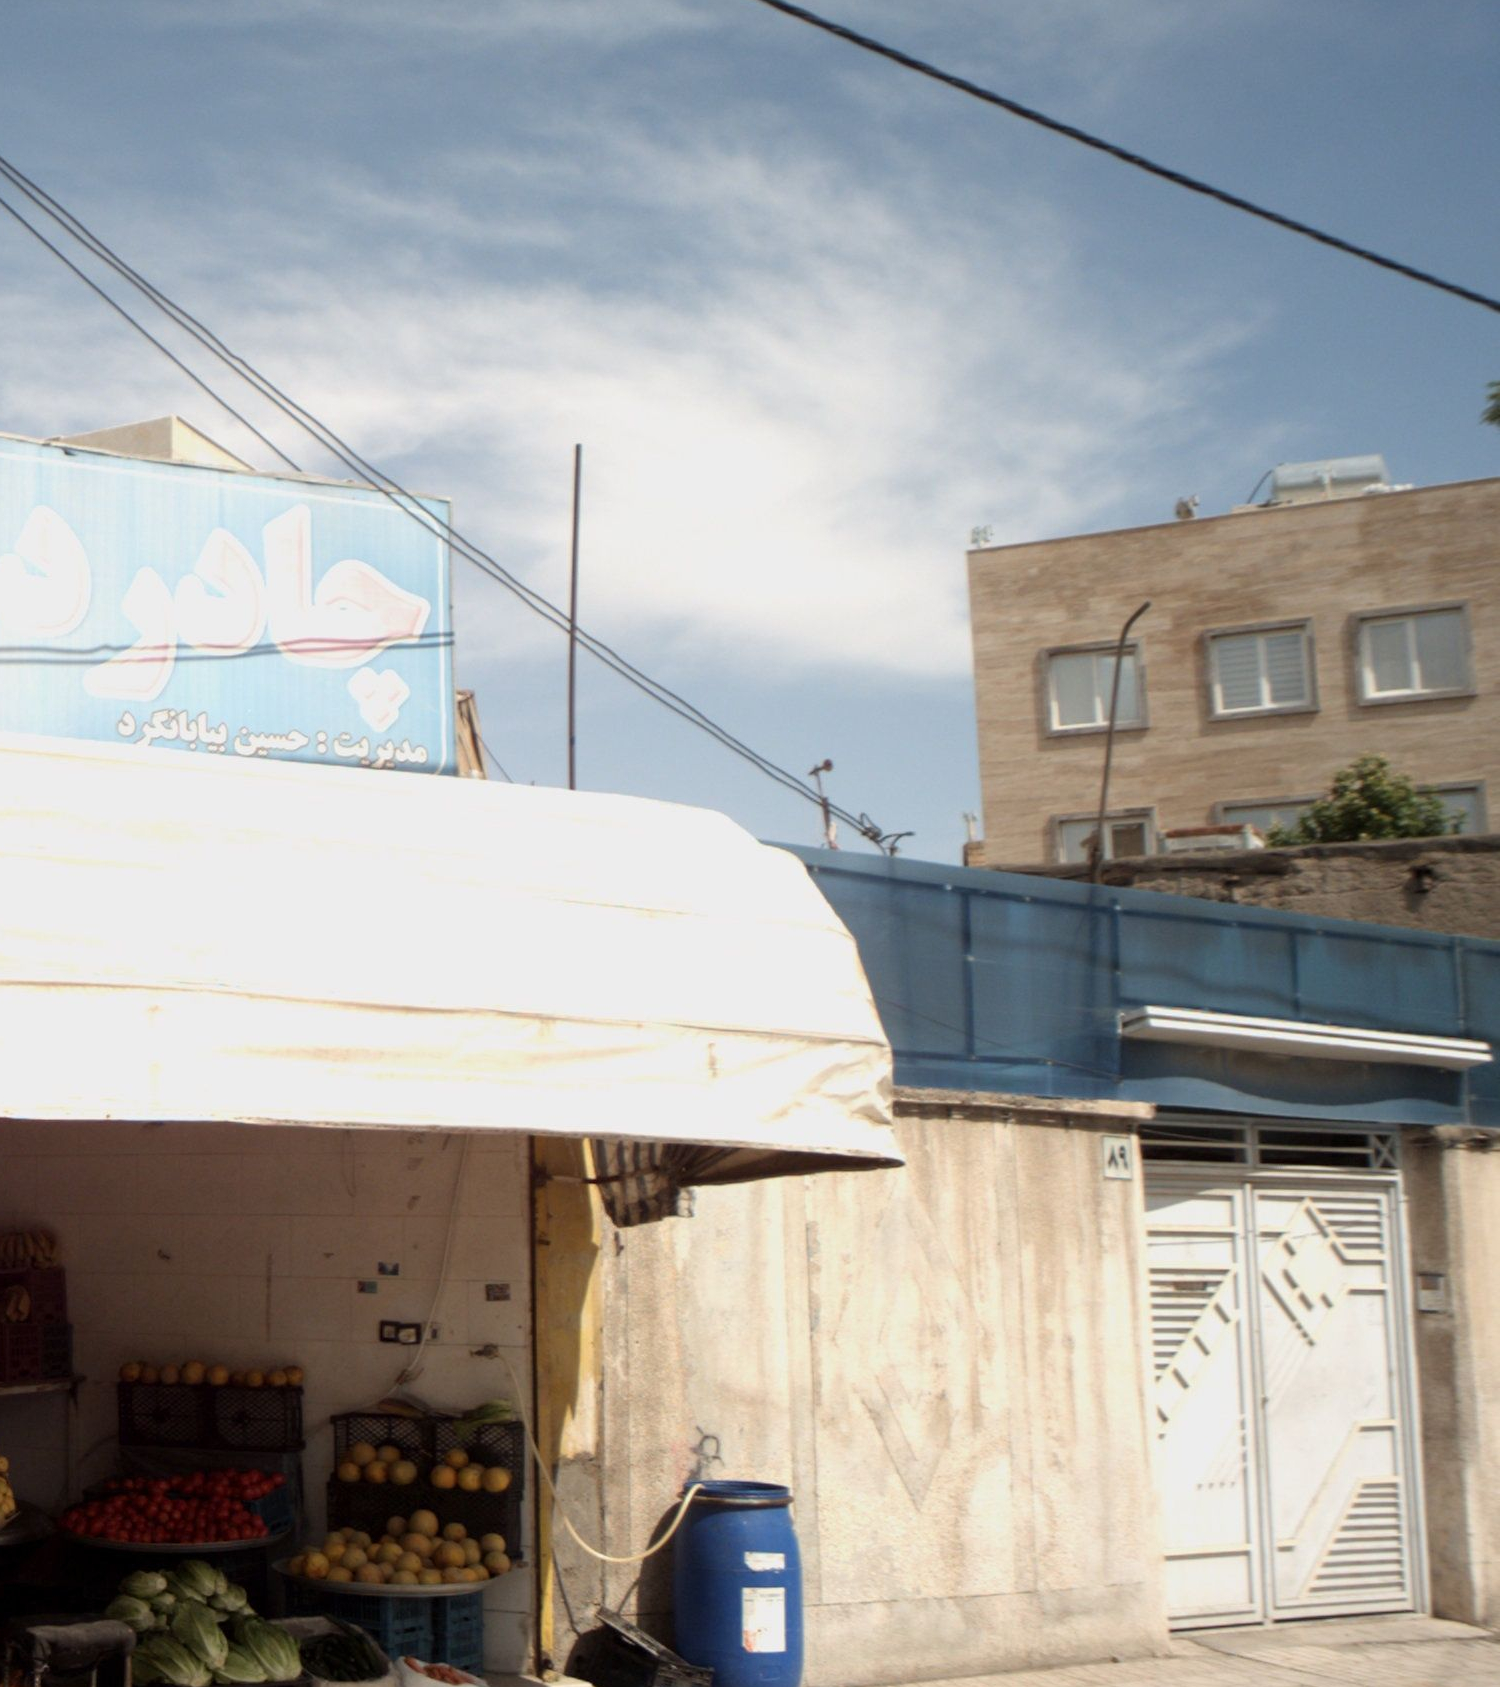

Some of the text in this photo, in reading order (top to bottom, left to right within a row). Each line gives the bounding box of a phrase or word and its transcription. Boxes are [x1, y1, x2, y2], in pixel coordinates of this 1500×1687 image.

[83, 504, 431, 732] چادر
[116, 707, 228, 752] بیابانگرد
[234, 726, 310, 756] حسین
